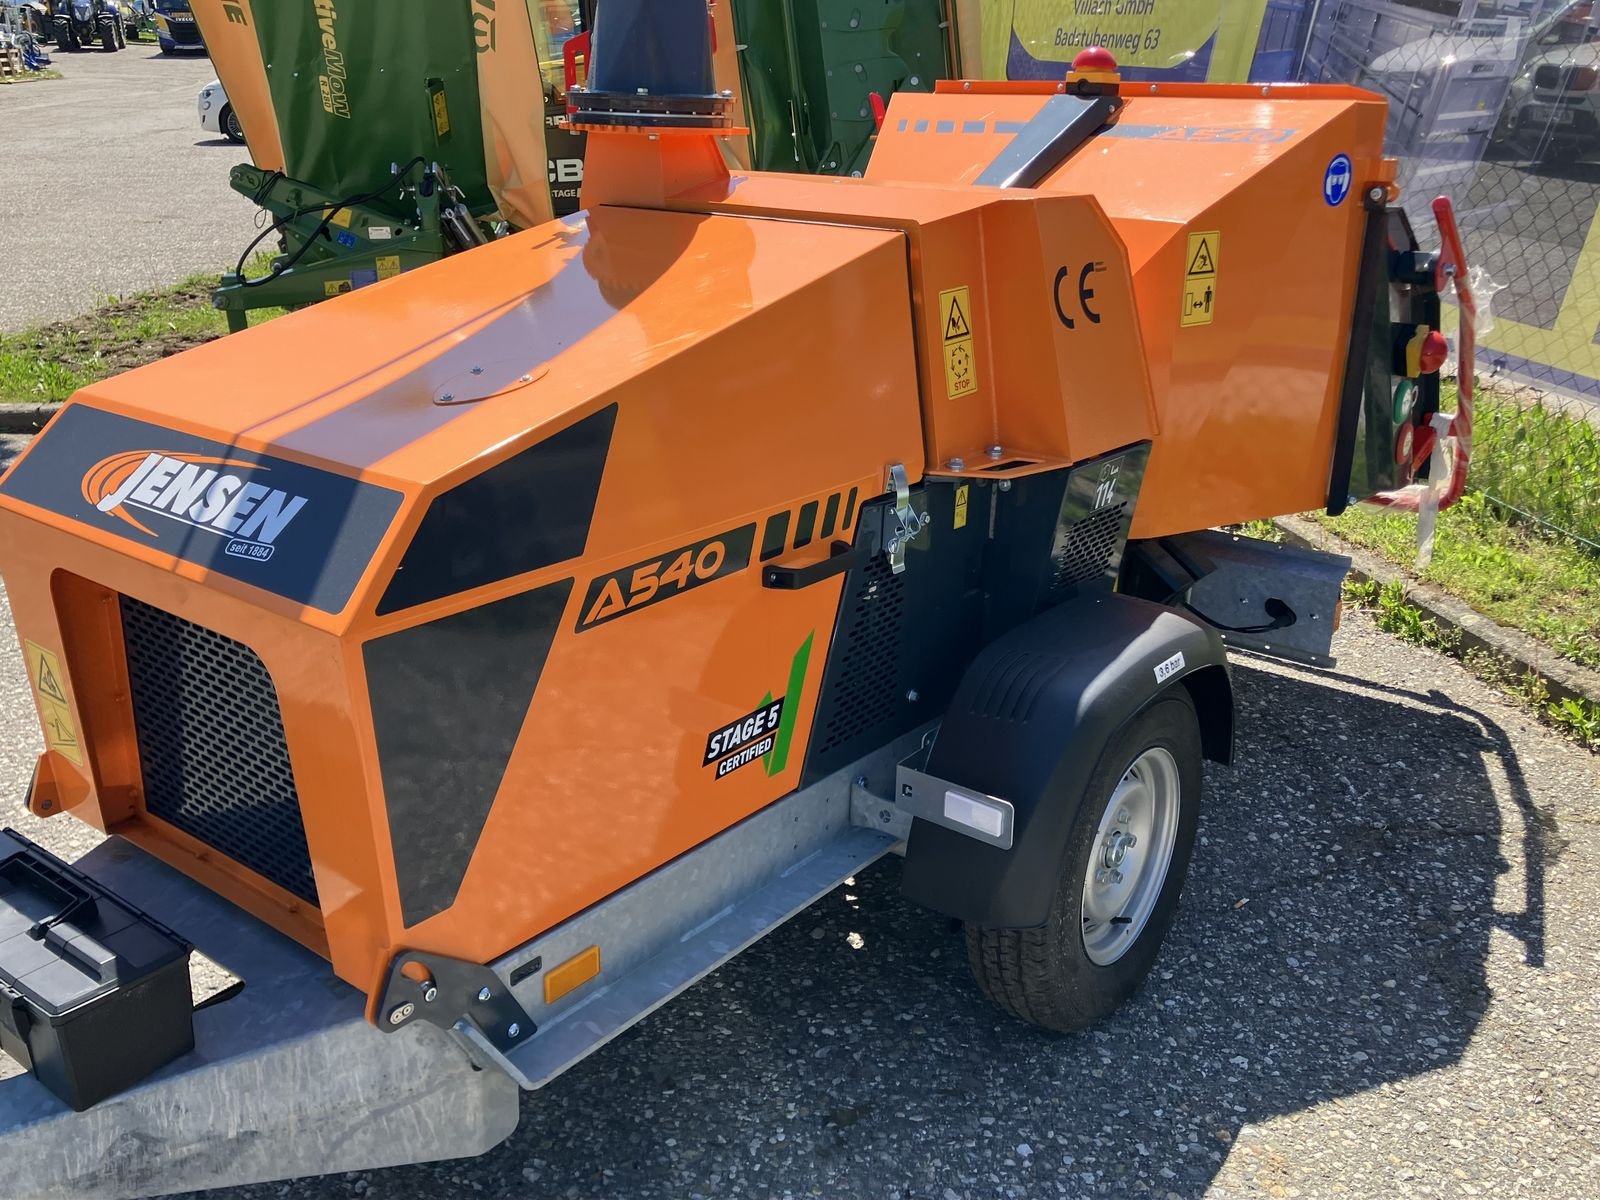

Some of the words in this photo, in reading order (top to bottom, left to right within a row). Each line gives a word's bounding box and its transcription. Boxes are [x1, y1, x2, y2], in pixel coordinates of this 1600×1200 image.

[1073, 0, 1113, 15] Villach
[1114, 0, 1155, 15] GmbH
[1054, 27, 1142, 55] Badstubenweg
[1143, 29, 1161, 50] 63
[551, 189, 577, 198] TAGE
[954, 379, 971, 391] STOP
[96, 452, 309, 544] JENSEN
[1095, 478, 1117, 509] 114
[229, 543, 248, 554] seit
[247, 545, 270, 558] 1884
[582, 541, 726, 625] A540
[1170, 659, 1180, 671] bar
[707, 710, 767, 759] STAGE
[767, 703, 780, 728] 5
[719, 737, 772, 775] CERTIFIED
